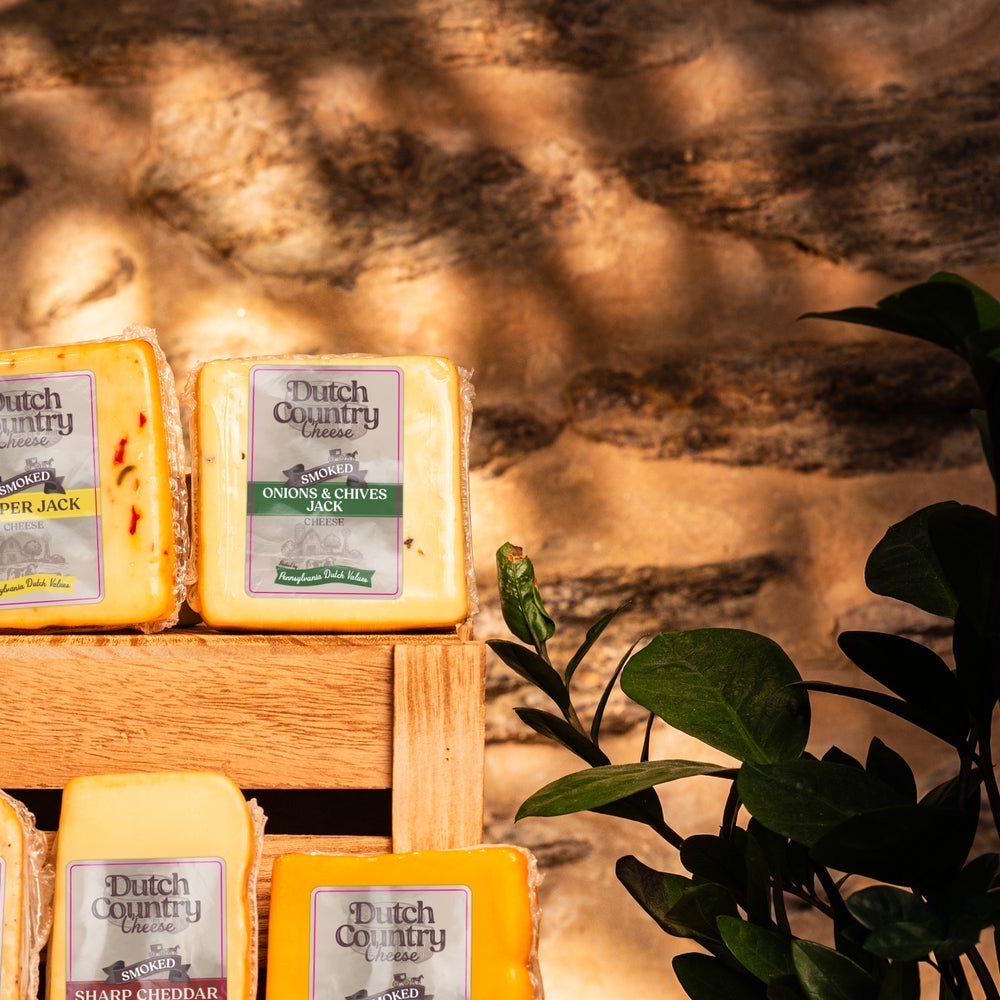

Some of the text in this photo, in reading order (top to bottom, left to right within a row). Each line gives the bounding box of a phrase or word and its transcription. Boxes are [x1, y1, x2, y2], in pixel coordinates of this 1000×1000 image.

[287, 380, 369, 402] Dutch
[273, 401, 379, 430] Country
[302, 421, 353, 438] Cheese
[0, 471, 50, 496] SMOKED
[301, 463, 353, 485] SMOKED
[263, 487, 387, 500] ONIONS & CHIVES
[37, 498, 80, 512] JACK
[307, 501, 343, 512] JACK
[4, 521, 44, 531] CHEESE
[304, 518, 344, 526] CHEESE
[26, 578, 46, 588] Dutch
[50, 579, 70, 588] Values
[279, 570, 368, 584] Pennsylvania Dutch Values
[105, 873, 189, 896] Dutch
[92, 897, 201, 923] Country
[350, 901, 435, 924] Dutch
[121, 914, 175, 933] Cheese
[336, 925, 446, 953] Country
[365, 942, 420, 962] Cheese
[122, 958, 175, 981] SMOKED
[137, 987, 218, 1000] CHEDDAR
